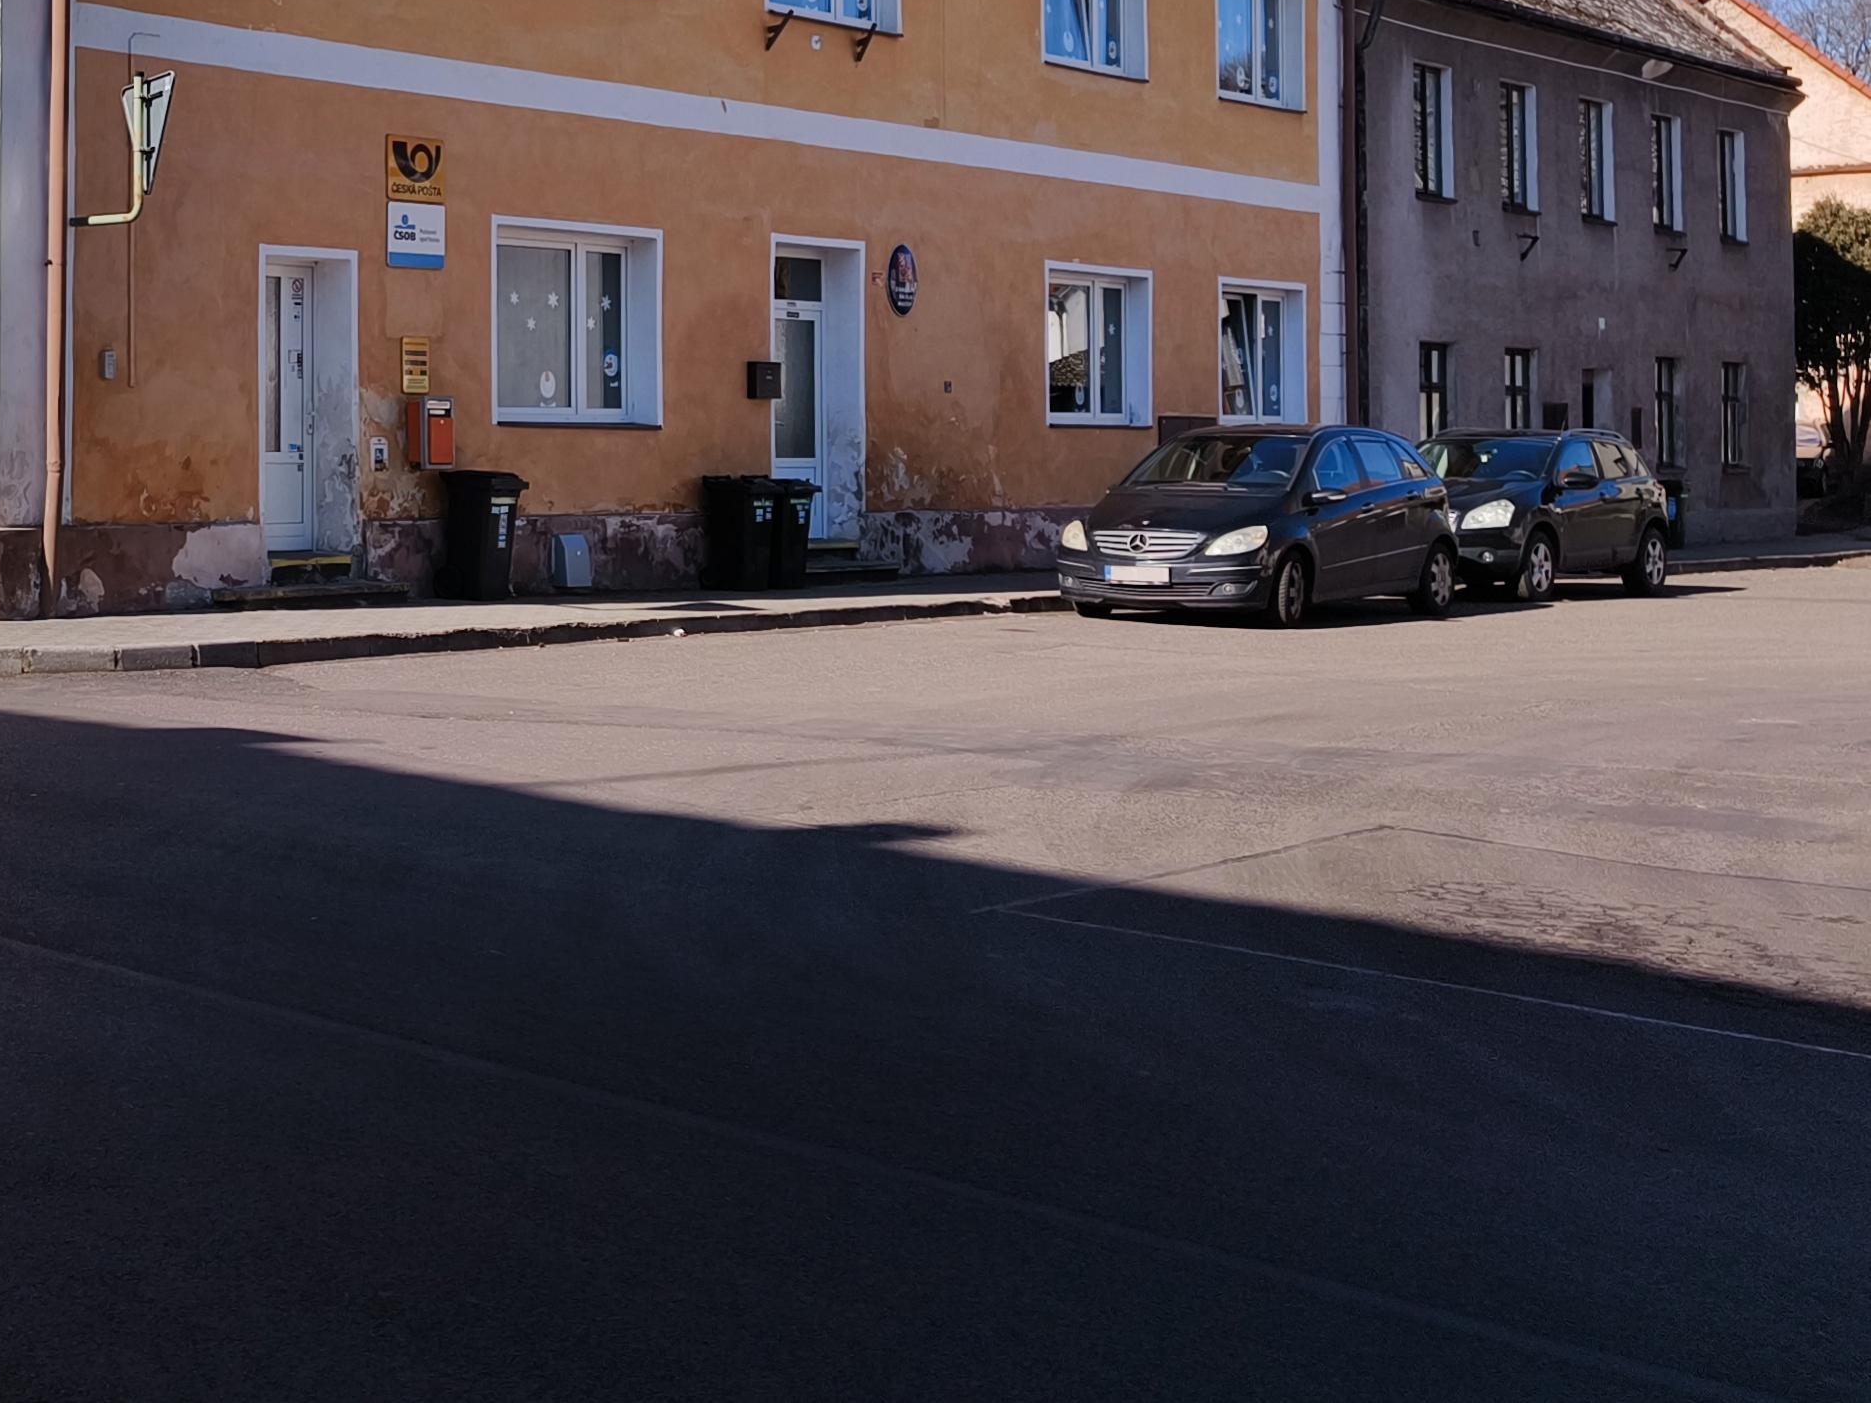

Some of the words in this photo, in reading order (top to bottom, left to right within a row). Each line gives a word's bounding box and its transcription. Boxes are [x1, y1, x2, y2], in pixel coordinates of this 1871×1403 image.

[391, 182, 417, 196] ČESKÁ
[418, 185, 442, 197] POŠTA
[393, 229, 417, 242] ČSOB
